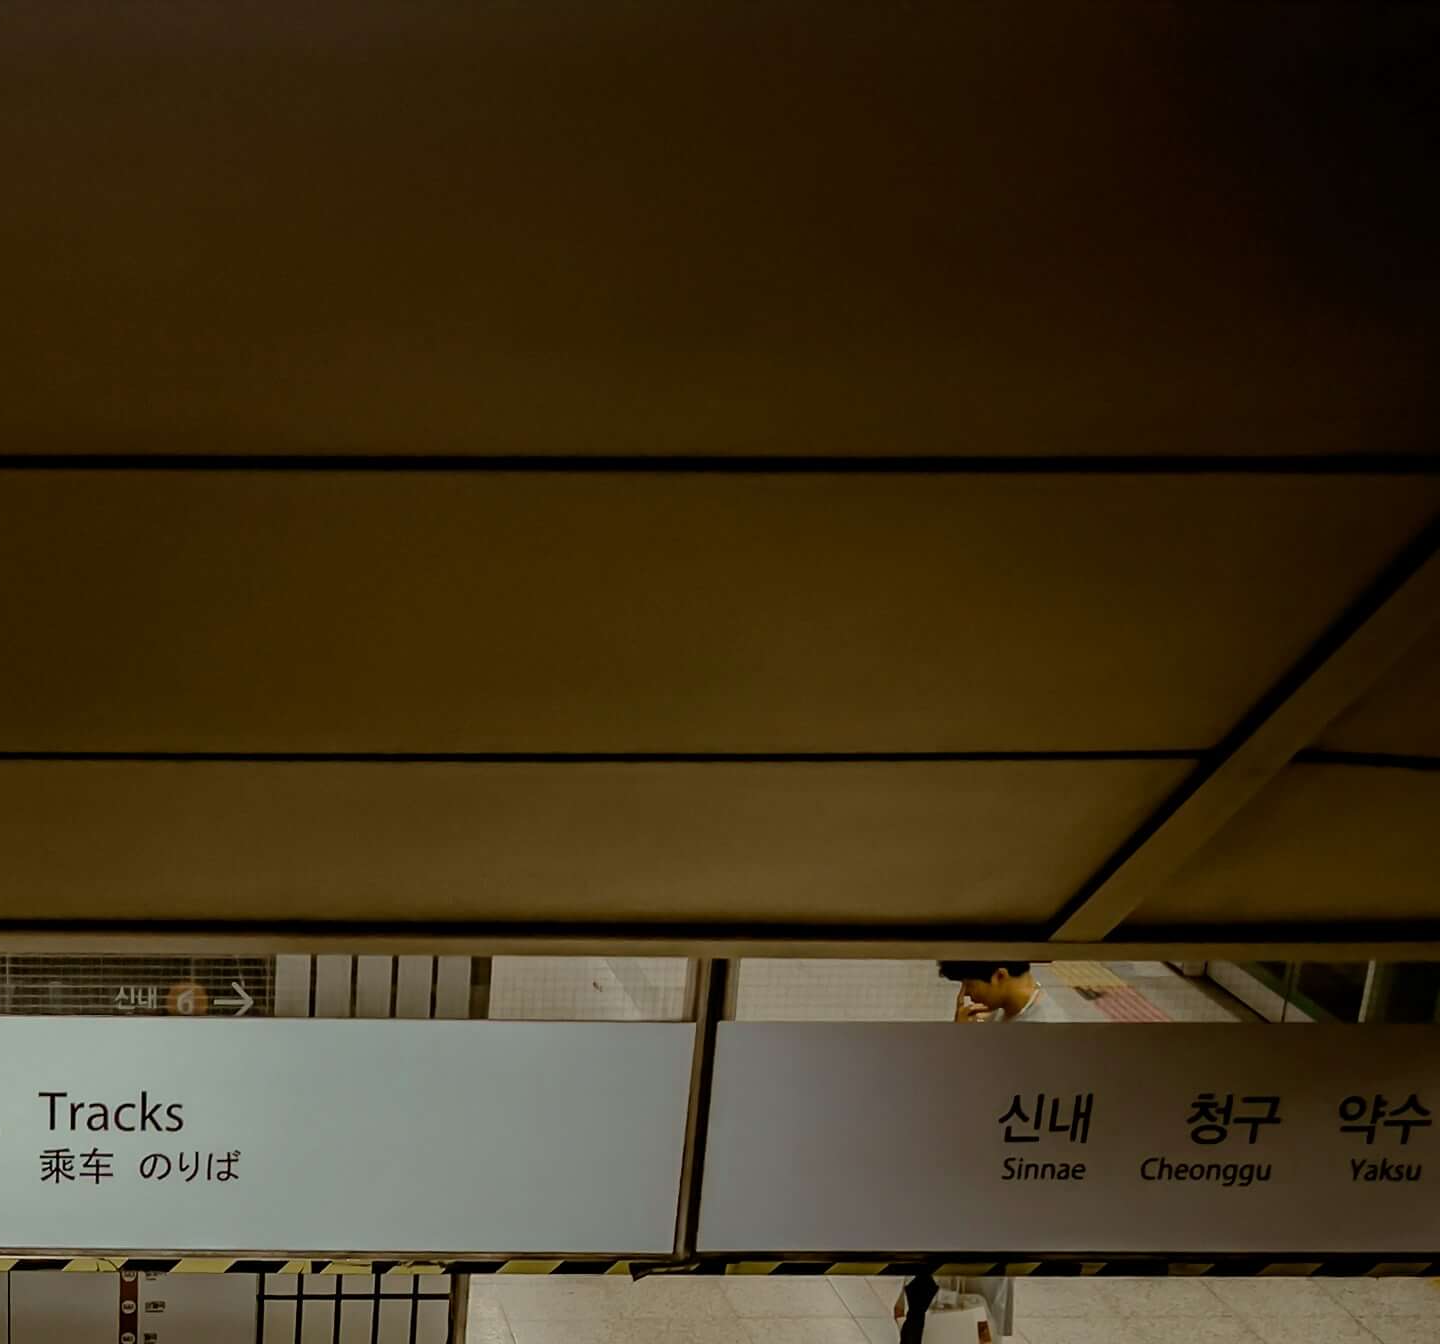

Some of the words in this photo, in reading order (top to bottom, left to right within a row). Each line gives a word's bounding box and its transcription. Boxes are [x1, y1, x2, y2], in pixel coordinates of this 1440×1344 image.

[38, 1091, 185, 1133] Tracks
[998, 1093, 1094, 1144] 신내
[1186, 1093, 1282, 1145] 청구
[1338, 1093, 1433, 1146] 약수
[39, 1148, 115, 1185] 乘车
[139, 1149, 241, 1182] のりば
[1001, 1157, 1086, 1181] Sinnae
[1140, 1157, 1272, 1187] Cheonggu
[1349, 1158, 1422, 1182] Yaksu
